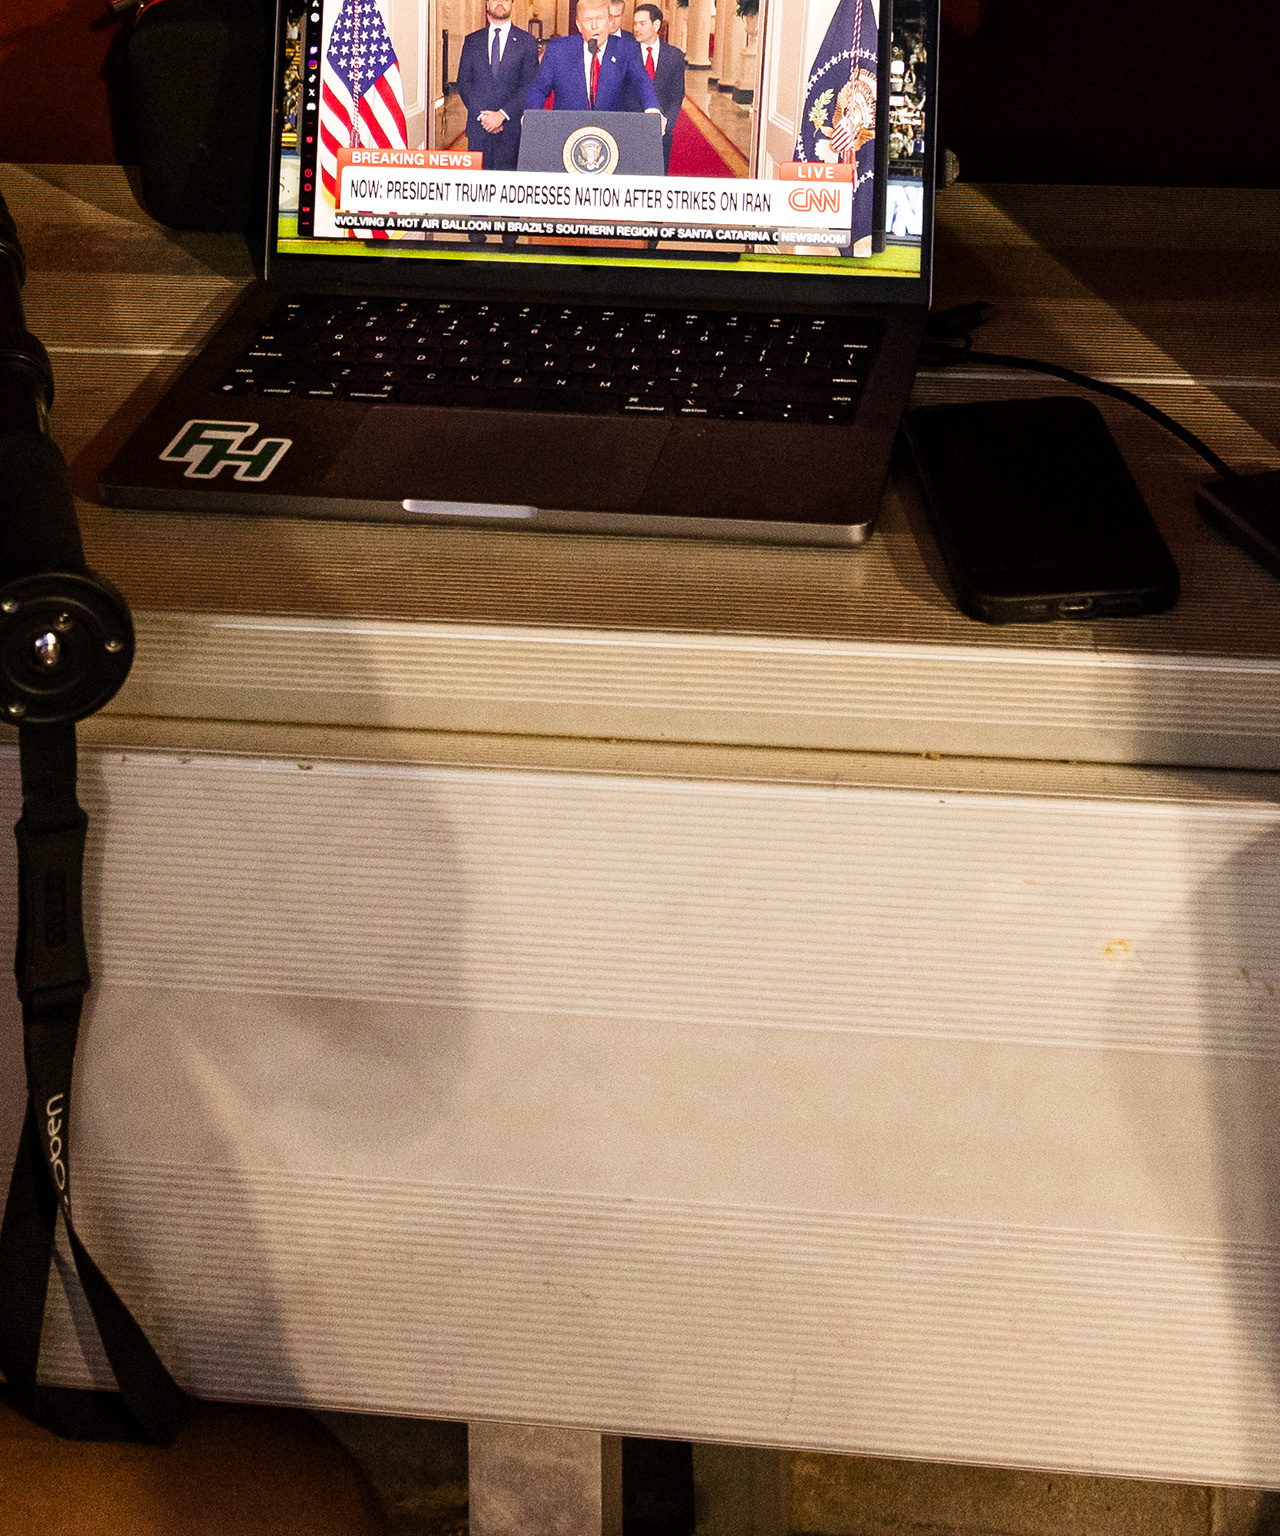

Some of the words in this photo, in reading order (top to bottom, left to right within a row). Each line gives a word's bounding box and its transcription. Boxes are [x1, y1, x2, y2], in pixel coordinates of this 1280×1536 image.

[351, 151, 425, 166] BREAKING
[429, 153, 473, 167] NEWS
[797, 166, 835, 179] LIVE
[351, 178, 383, 200] NOW:
[387, 181, 451, 202] PRESIDENT
[456, 183, 497, 204] TRUMP
[500, 184, 571, 206] ADDRESSES
[575, 186, 620, 208] NATION
[624, 188, 663, 209] AFTER
[667, 189, 716, 211] STRIKES
[720, 192, 738, 212] ON
[742, 193, 771, 212] IRAN
[788, 188, 840, 214] CNN
[387, 217, 395, 228] A
[397, 217, 419, 229] HOT
[421, 219, 440, 230] AIR
[441, 219, 492, 232] BALLOON
[493, 221, 505, 232] IN
[508, 221, 554, 234] BRAZIL'S
[556, 223, 615, 236] SOUTHERN
[617, 225, 658, 238] REGION
[660, 227, 676, 239] OF
[677, 228, 714, 240] SANTA
[716, 229, 770, 242] CATARINA
[781, 231, 847, 245] NEWSROOM
[47, 1093, 66, 1191] Oben
